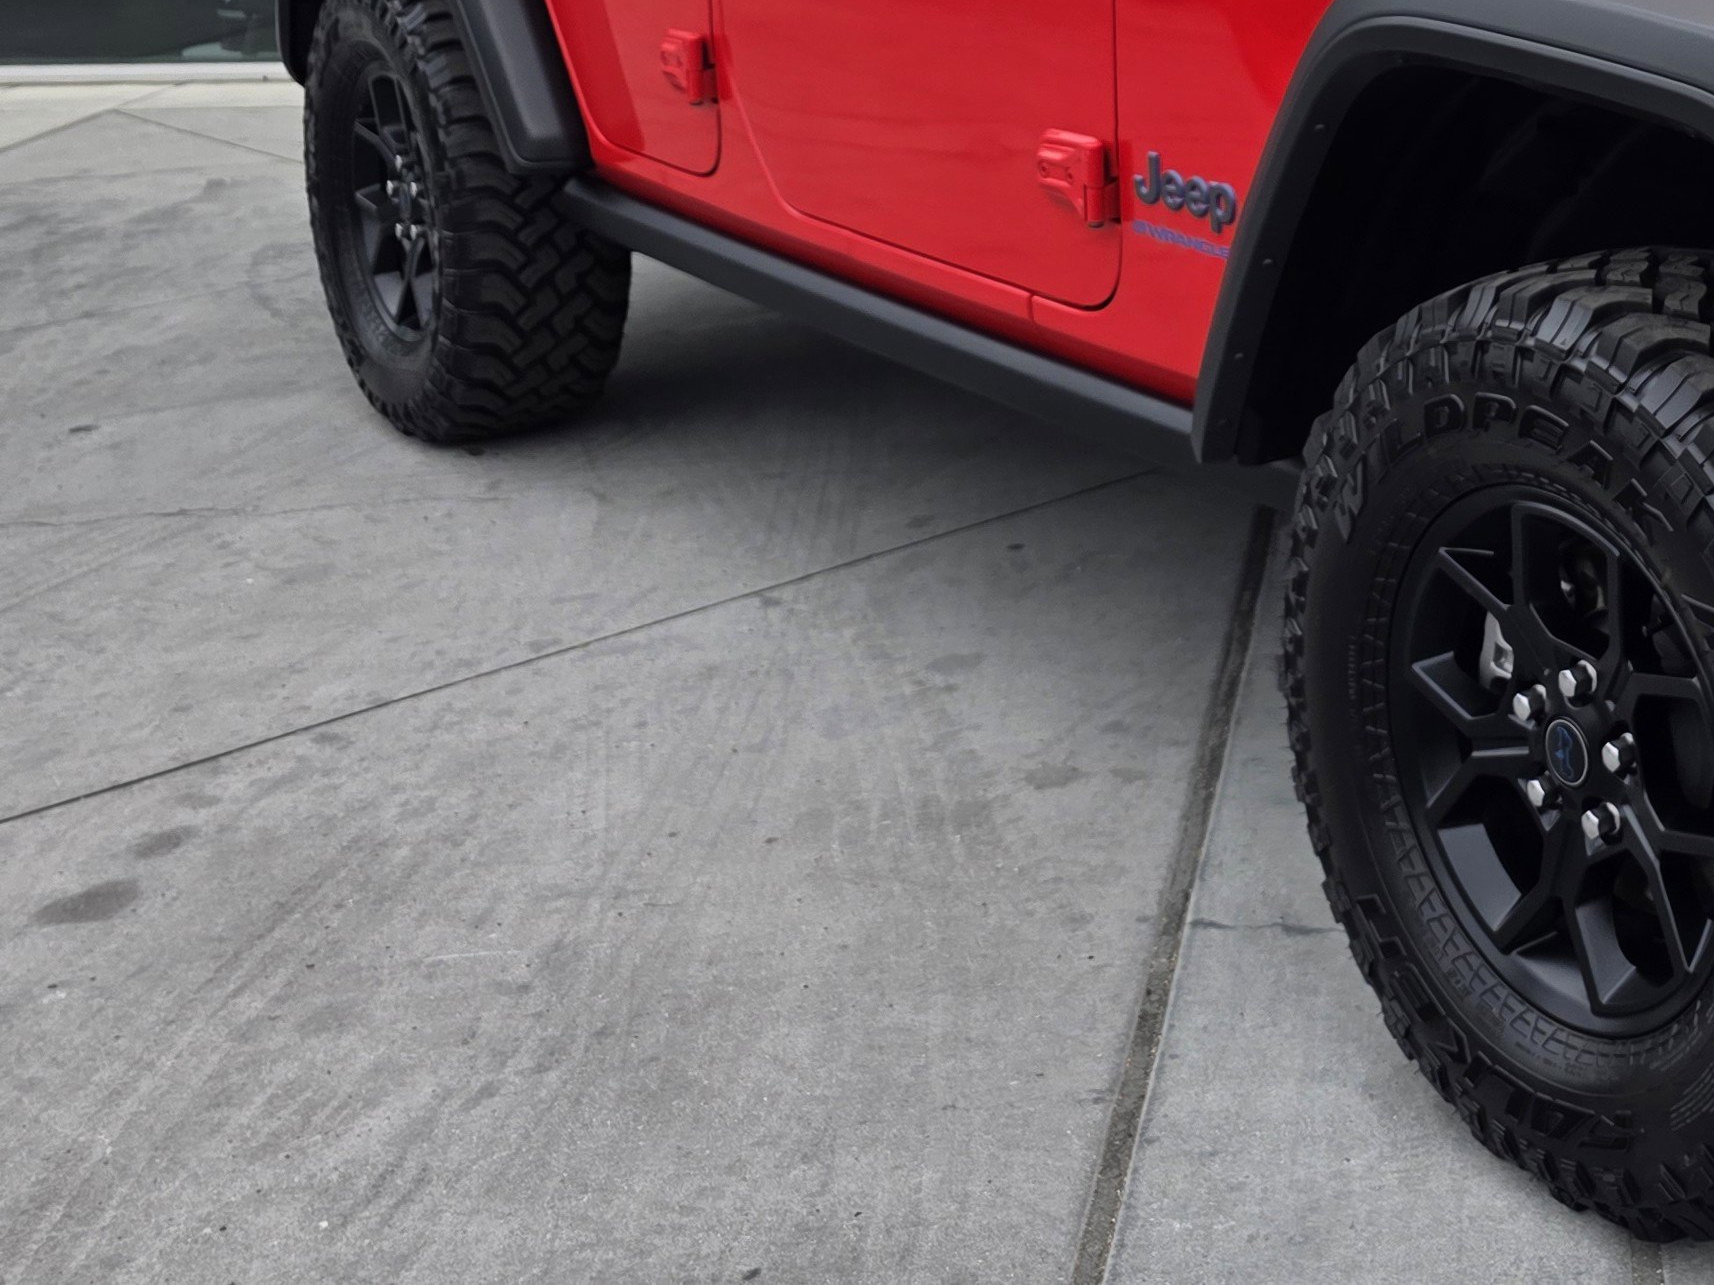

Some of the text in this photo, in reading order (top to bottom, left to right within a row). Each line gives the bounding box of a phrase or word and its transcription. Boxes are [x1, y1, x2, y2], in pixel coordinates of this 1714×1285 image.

[1133, 150, 1237, 234] Jeep
[1147, 221, 1231, 260] WRANGLE
[1356, 894, 1633, 1152] FALKEN
